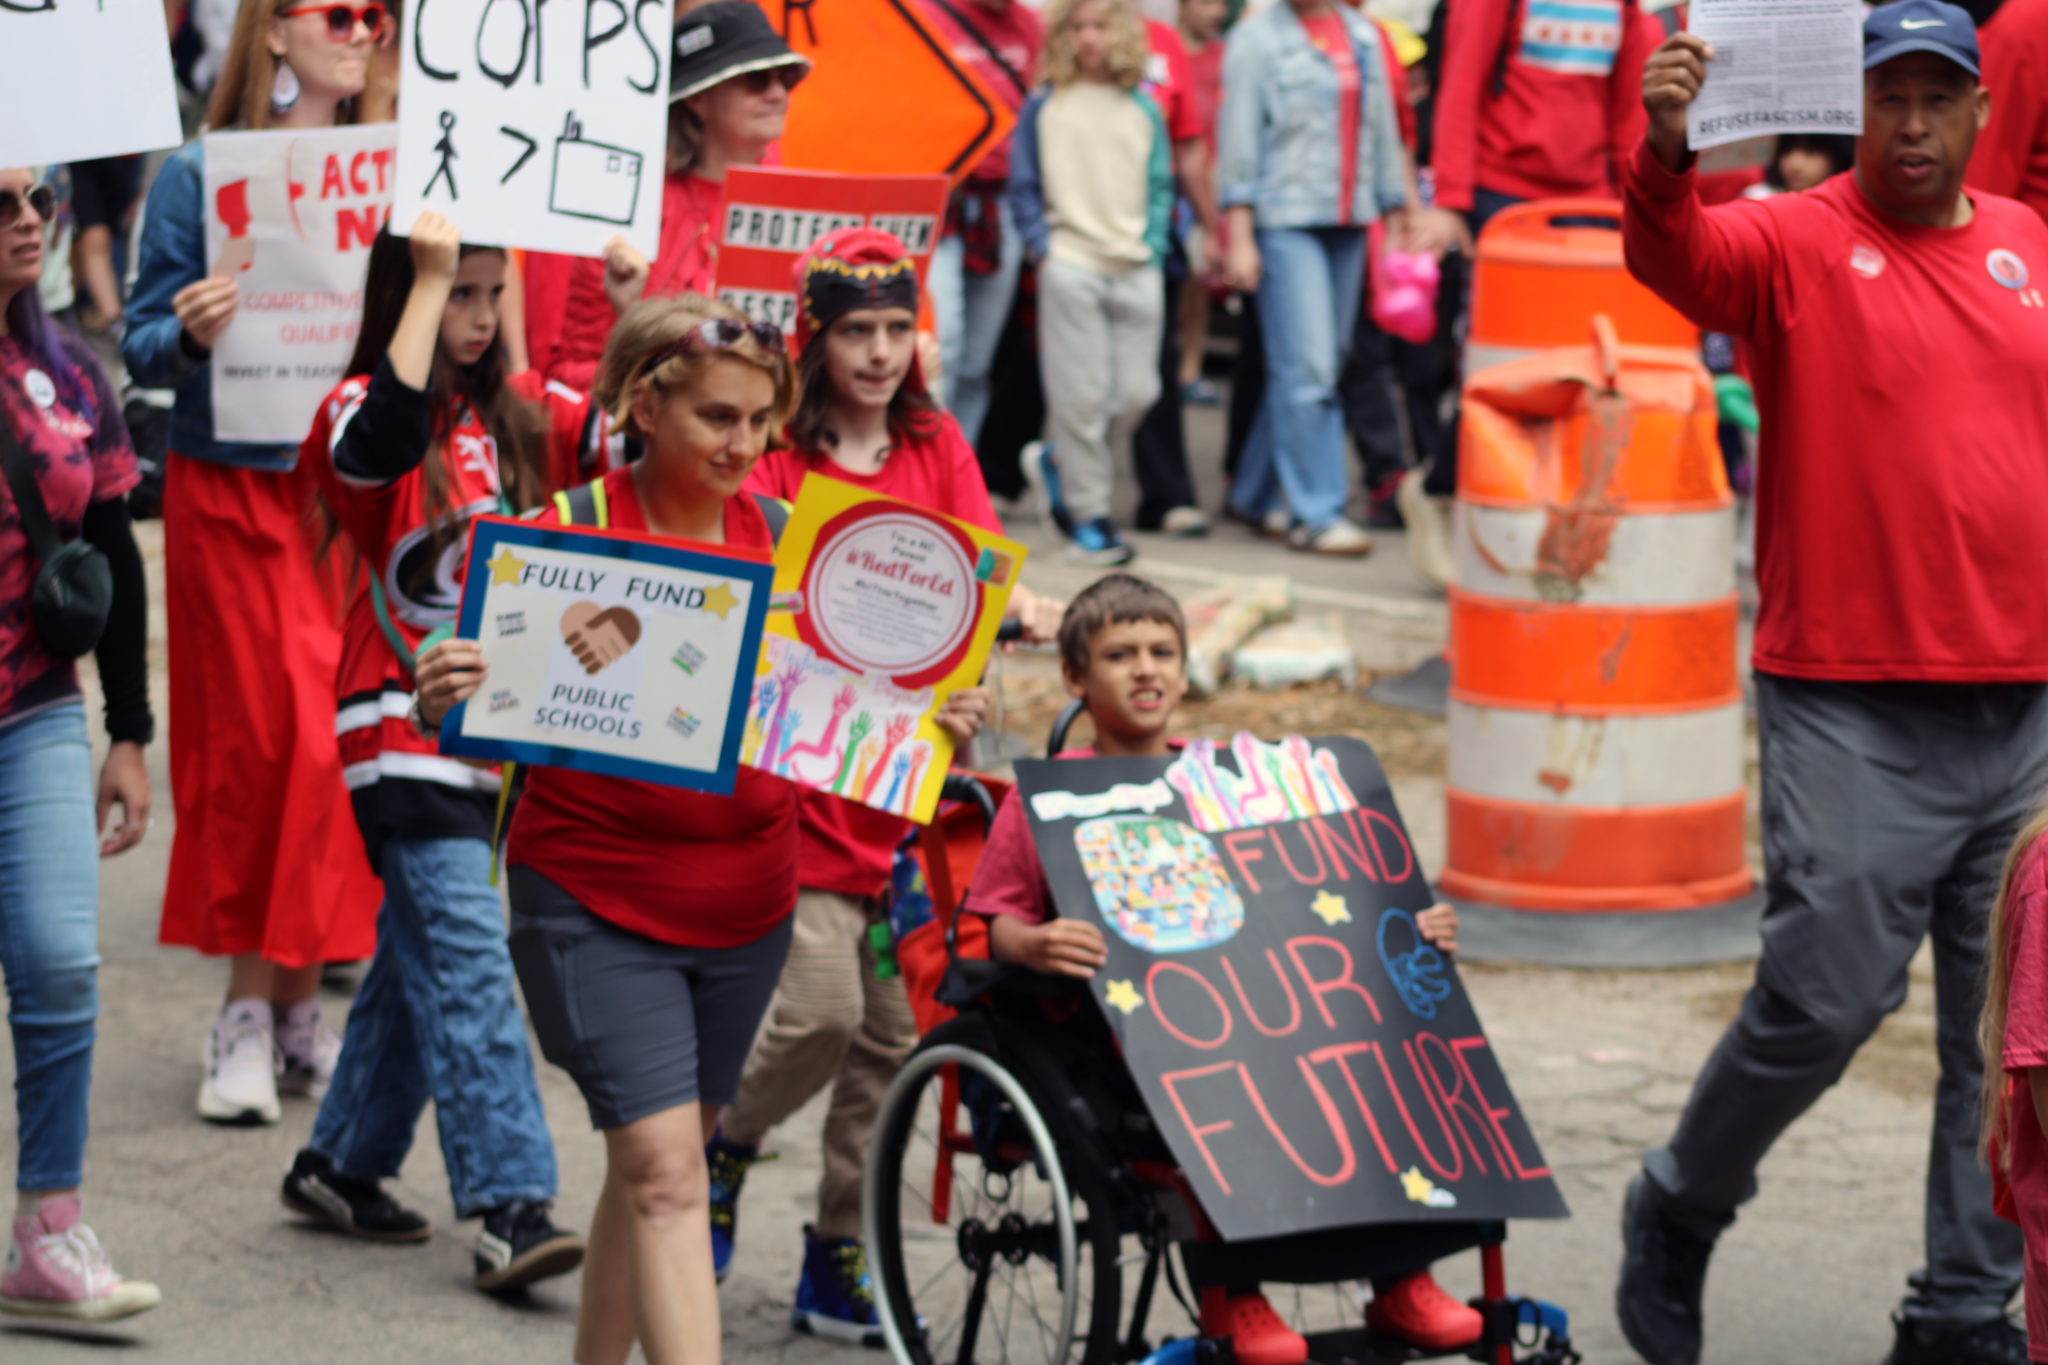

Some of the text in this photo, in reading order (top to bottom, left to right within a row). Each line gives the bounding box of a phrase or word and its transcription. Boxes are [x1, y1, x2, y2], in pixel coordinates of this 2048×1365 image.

[1699, 109, 1856, 134] REFUSEFASCISM.ORG
[729, 208, 860, 246] PROTE
[245, 291, 363, 312] COMPETITIVE
[224, 364, 271, 379] INVEST
[276, 365, 290, 378] IN
[892, 545, 927, 563] Parent
[919, 541, 937, 553] NC
[522, 563, 706, 610] FULLY FUND
[845, 548, 956, 597] #RedForEd
[552, 683, 634, 713] PUBLIC
[534, 707, 642, 740] SCHOOLS
[1223, 805, 1413, 895] FUND
[1145, 935, 1383, 1050] OUR
[1160, 1031, 1552, 1196] FUTURE
